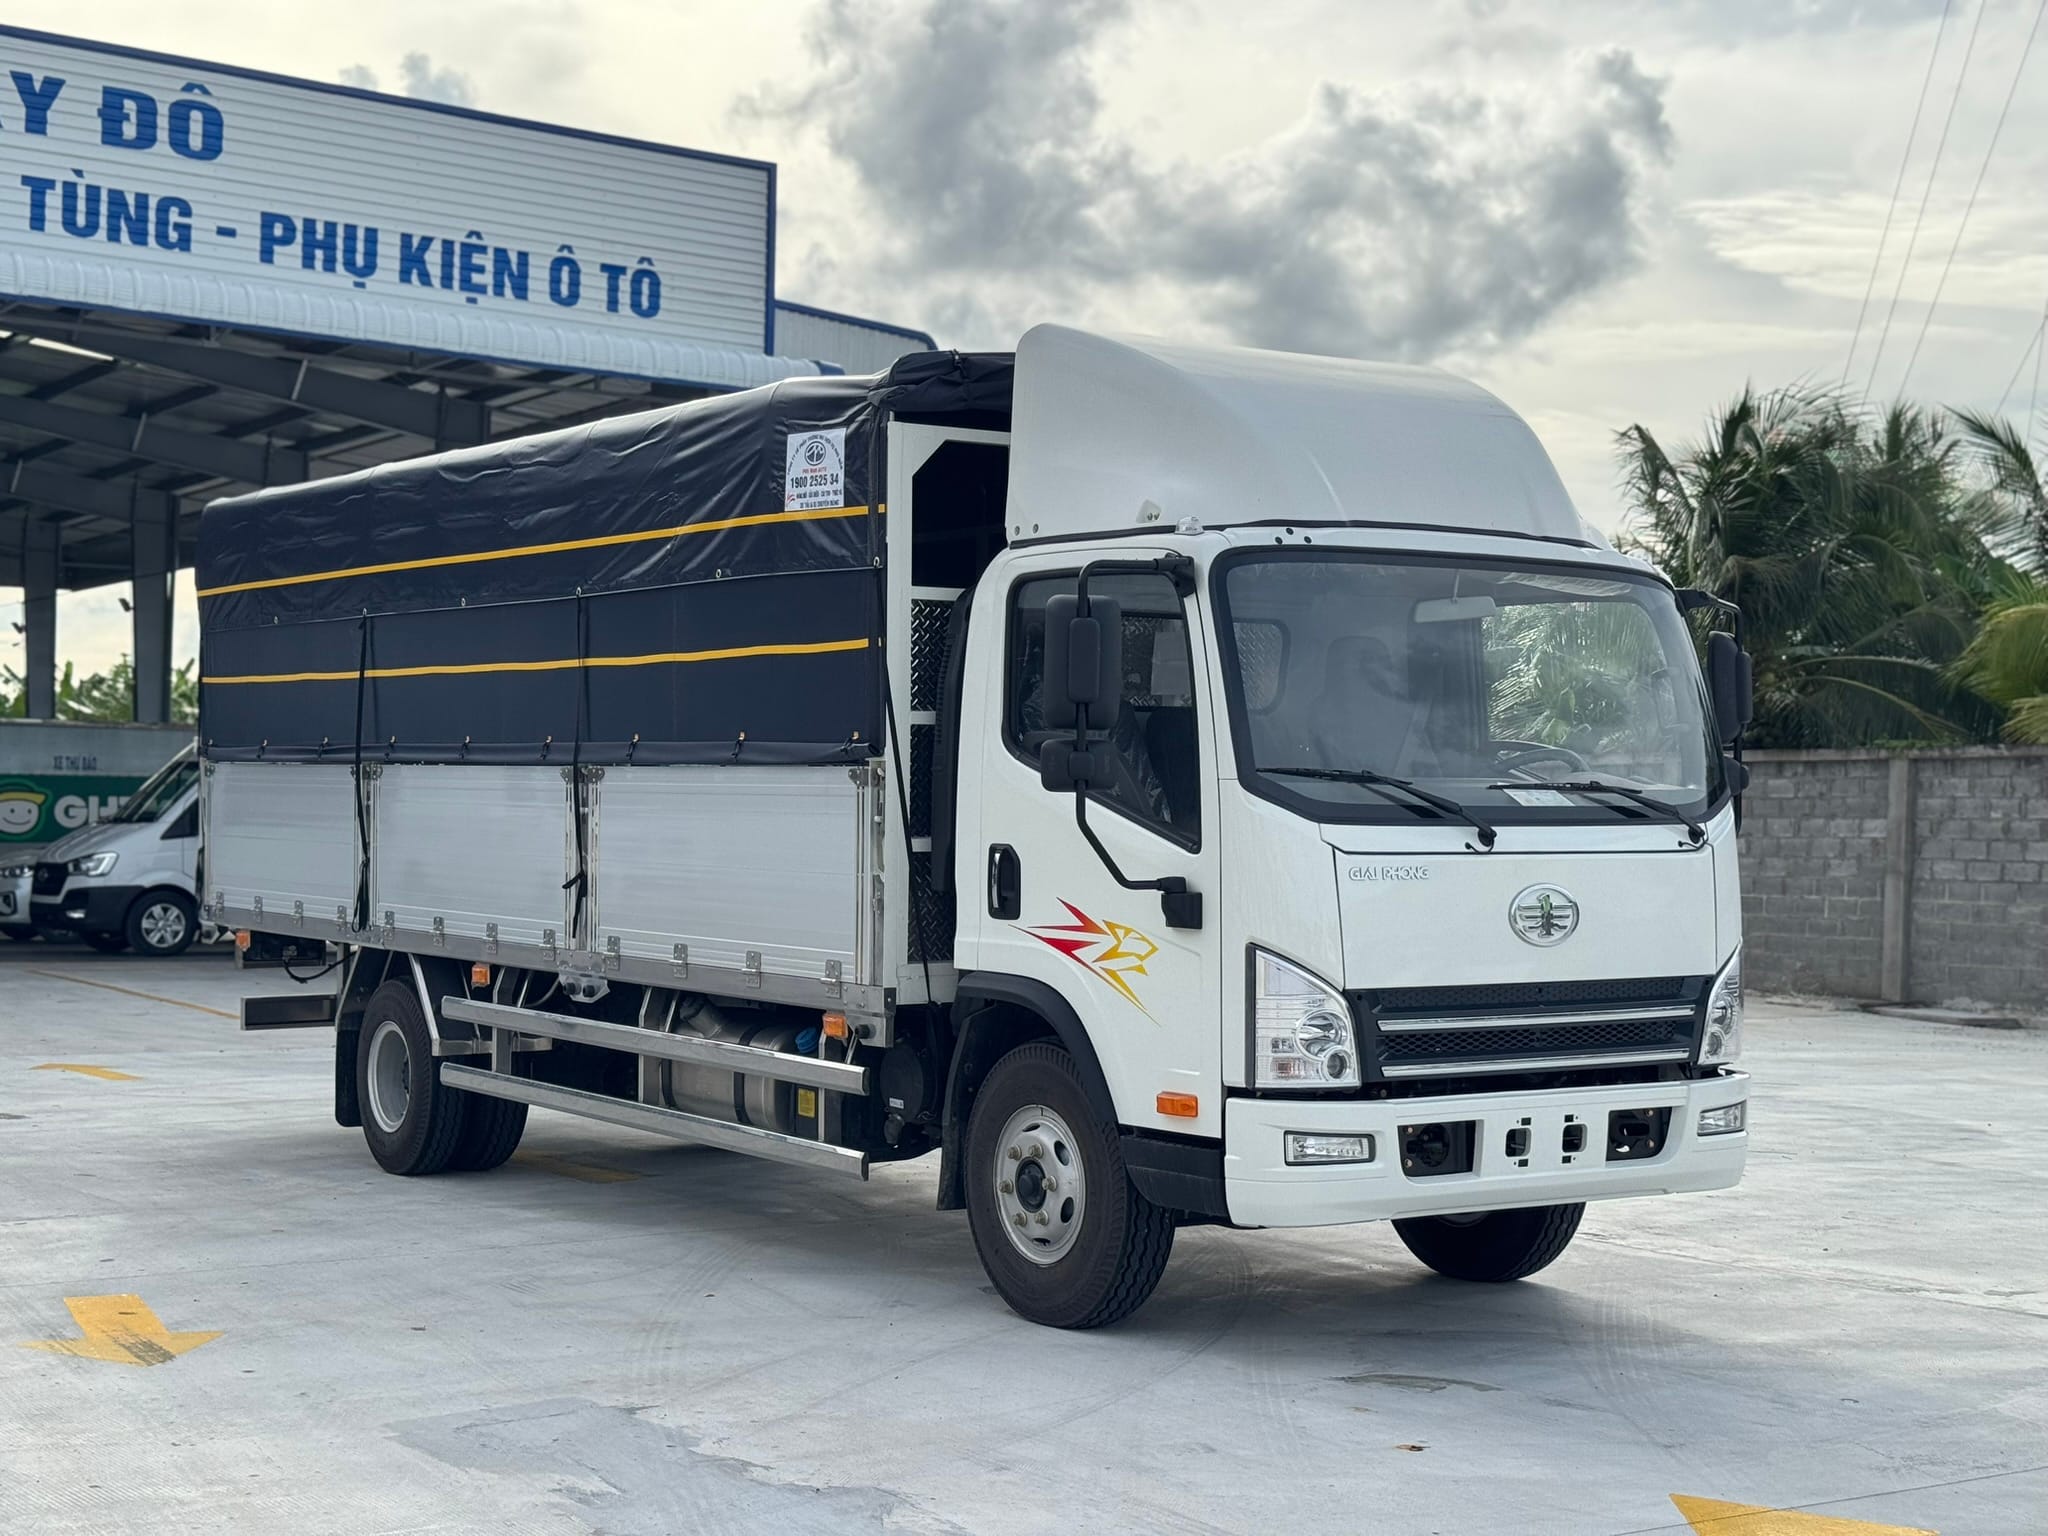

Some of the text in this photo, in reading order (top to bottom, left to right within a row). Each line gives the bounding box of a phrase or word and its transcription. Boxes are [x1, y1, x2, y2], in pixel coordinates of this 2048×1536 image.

[0, 70, 225, 161] Y ĐÔ
[20, 168, 193, 252] TÙNG
[259, 210, 378, 289] PHỤ
[399, 230, 530, 305] KIỆN
[549, 244, 581, 307] Ô
[600, 256, 662, 319] TÔ
[790, 473, 839, 488] 1900 2525 34
[1381, 865, 1430, 881] PHONG
